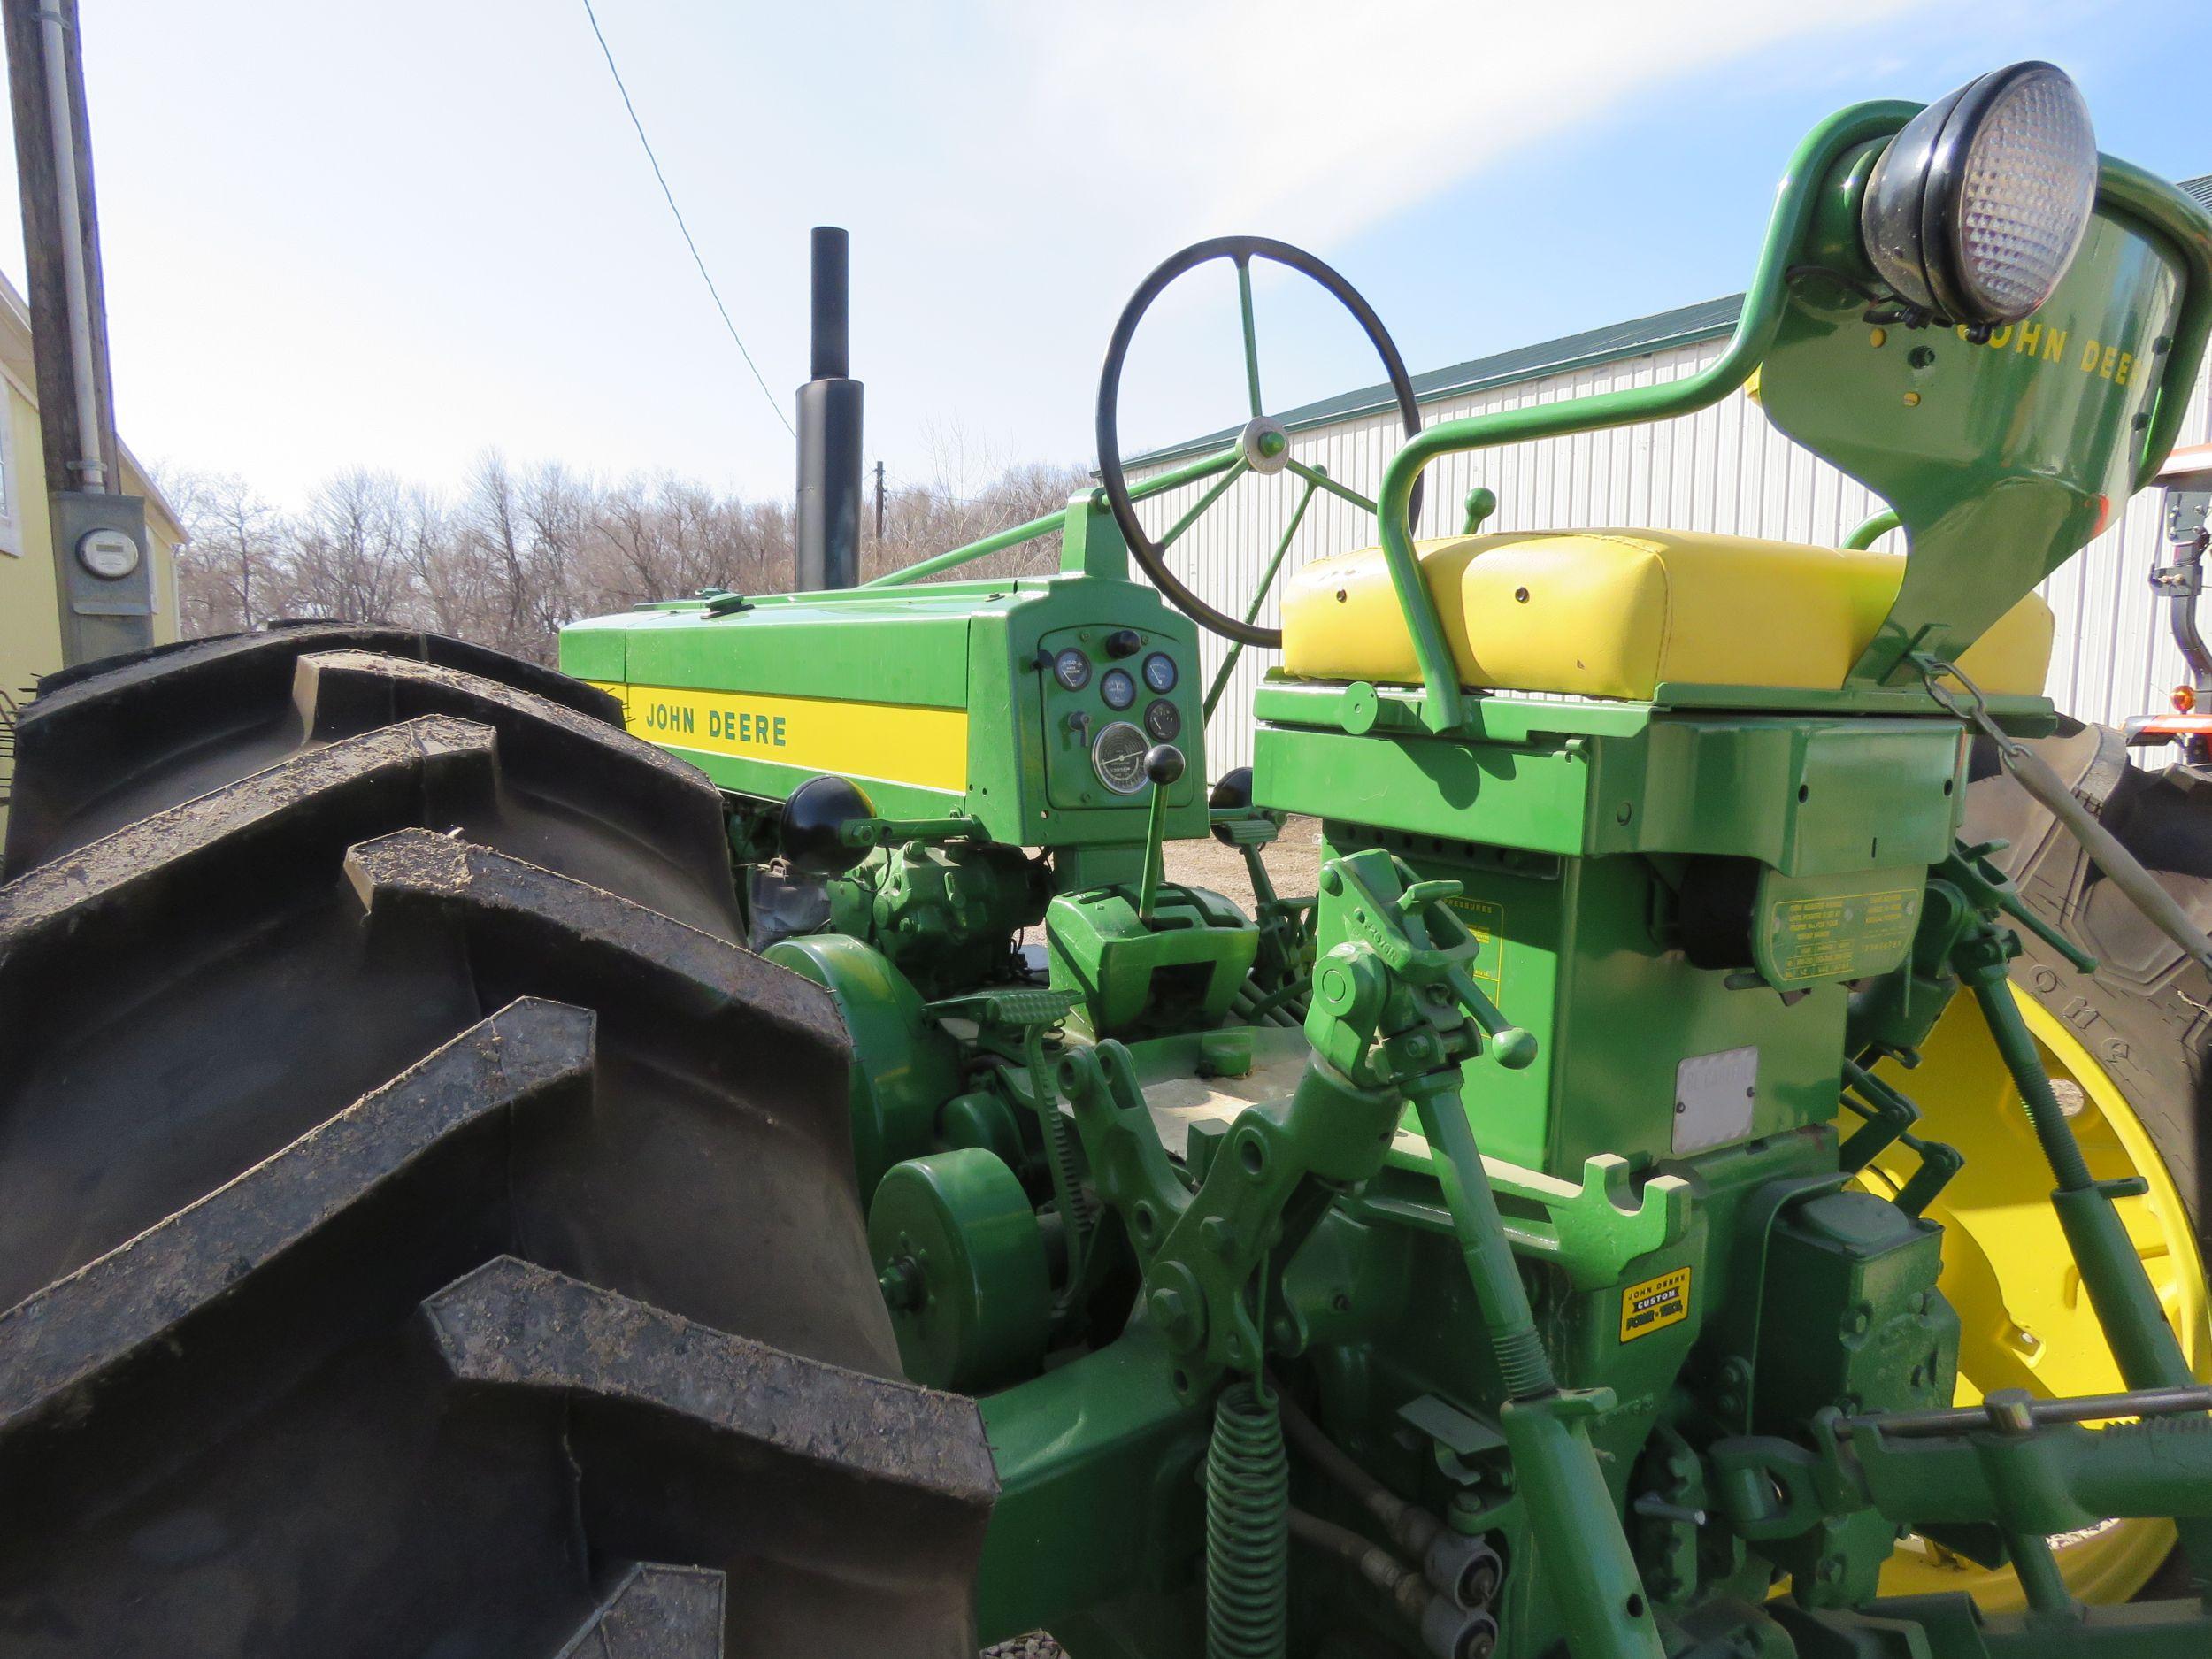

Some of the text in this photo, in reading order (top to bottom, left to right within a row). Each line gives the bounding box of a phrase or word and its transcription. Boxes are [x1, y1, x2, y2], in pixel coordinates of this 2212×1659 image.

[646, 703, 786, 746] JOHN DEERE
[1629, 1274, 1686, 1300] JOHN DEERE
[1637, 1289, 1676, 1310] CUSTOM
